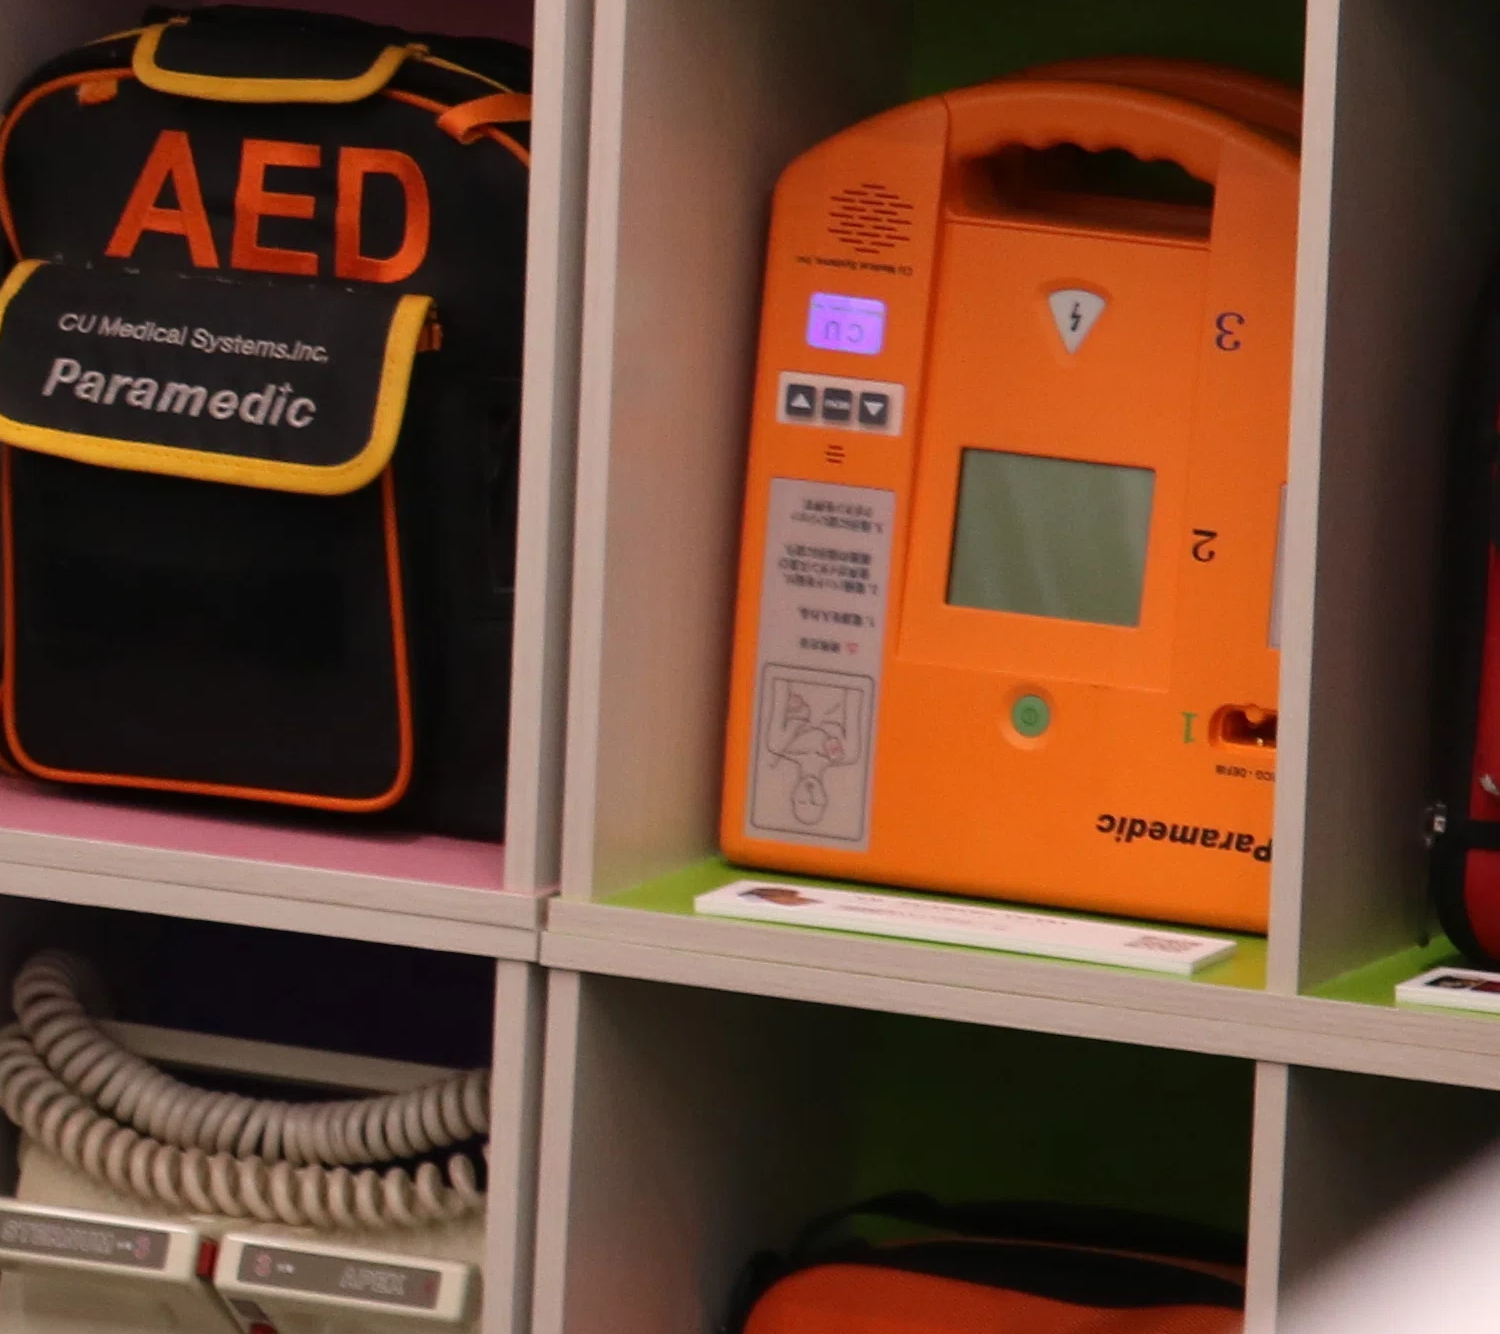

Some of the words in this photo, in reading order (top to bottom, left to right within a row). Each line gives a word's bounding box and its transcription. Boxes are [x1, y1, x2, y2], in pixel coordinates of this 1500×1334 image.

[105, 129, 431, 285] AED
[58, 313, 97, 334] CU
[99, 315, 189, 347] Medical
[1215, 312, 1245, 352] 3
[41, 357, 318, 429] Paramedic
[1191, 528, 1218, 563] 2
[1181, 710, 1195, 745] 1
[1095, 813, 1273, 864] Paramedic
